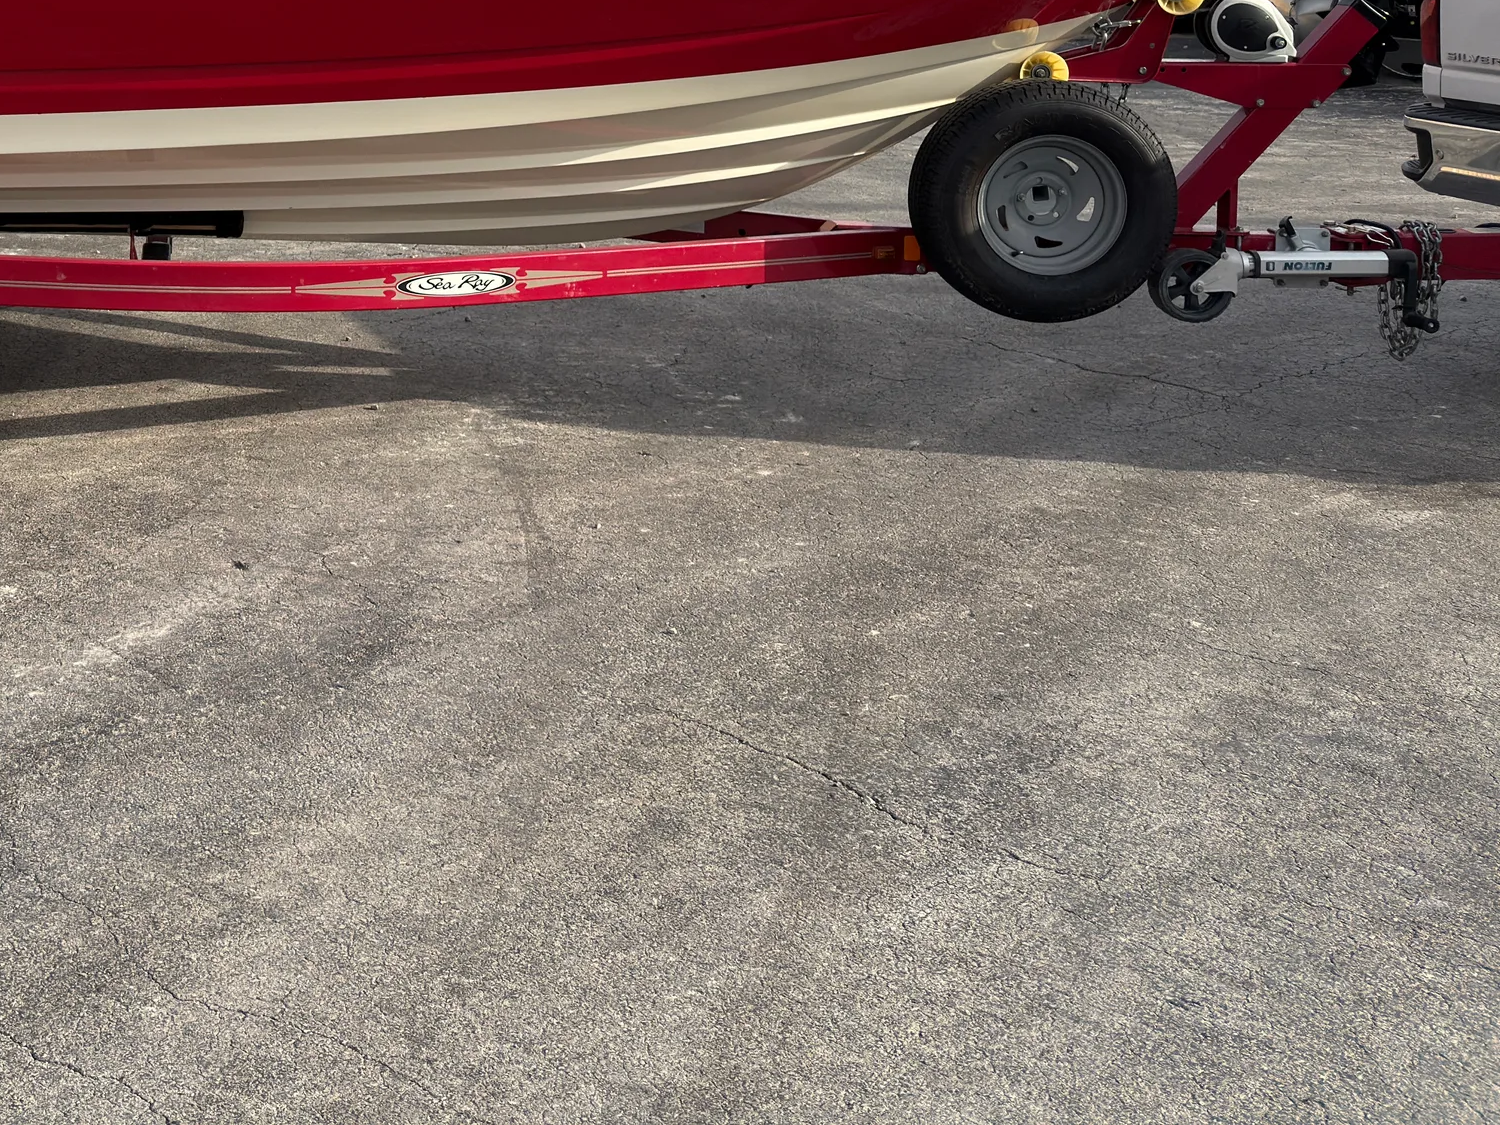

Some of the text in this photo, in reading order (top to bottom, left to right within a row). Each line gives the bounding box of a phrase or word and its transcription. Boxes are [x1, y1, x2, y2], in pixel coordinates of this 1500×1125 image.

[1283, 262, 1332, 271] FULTON
[418, 274, 495, 292] Sea Ray
